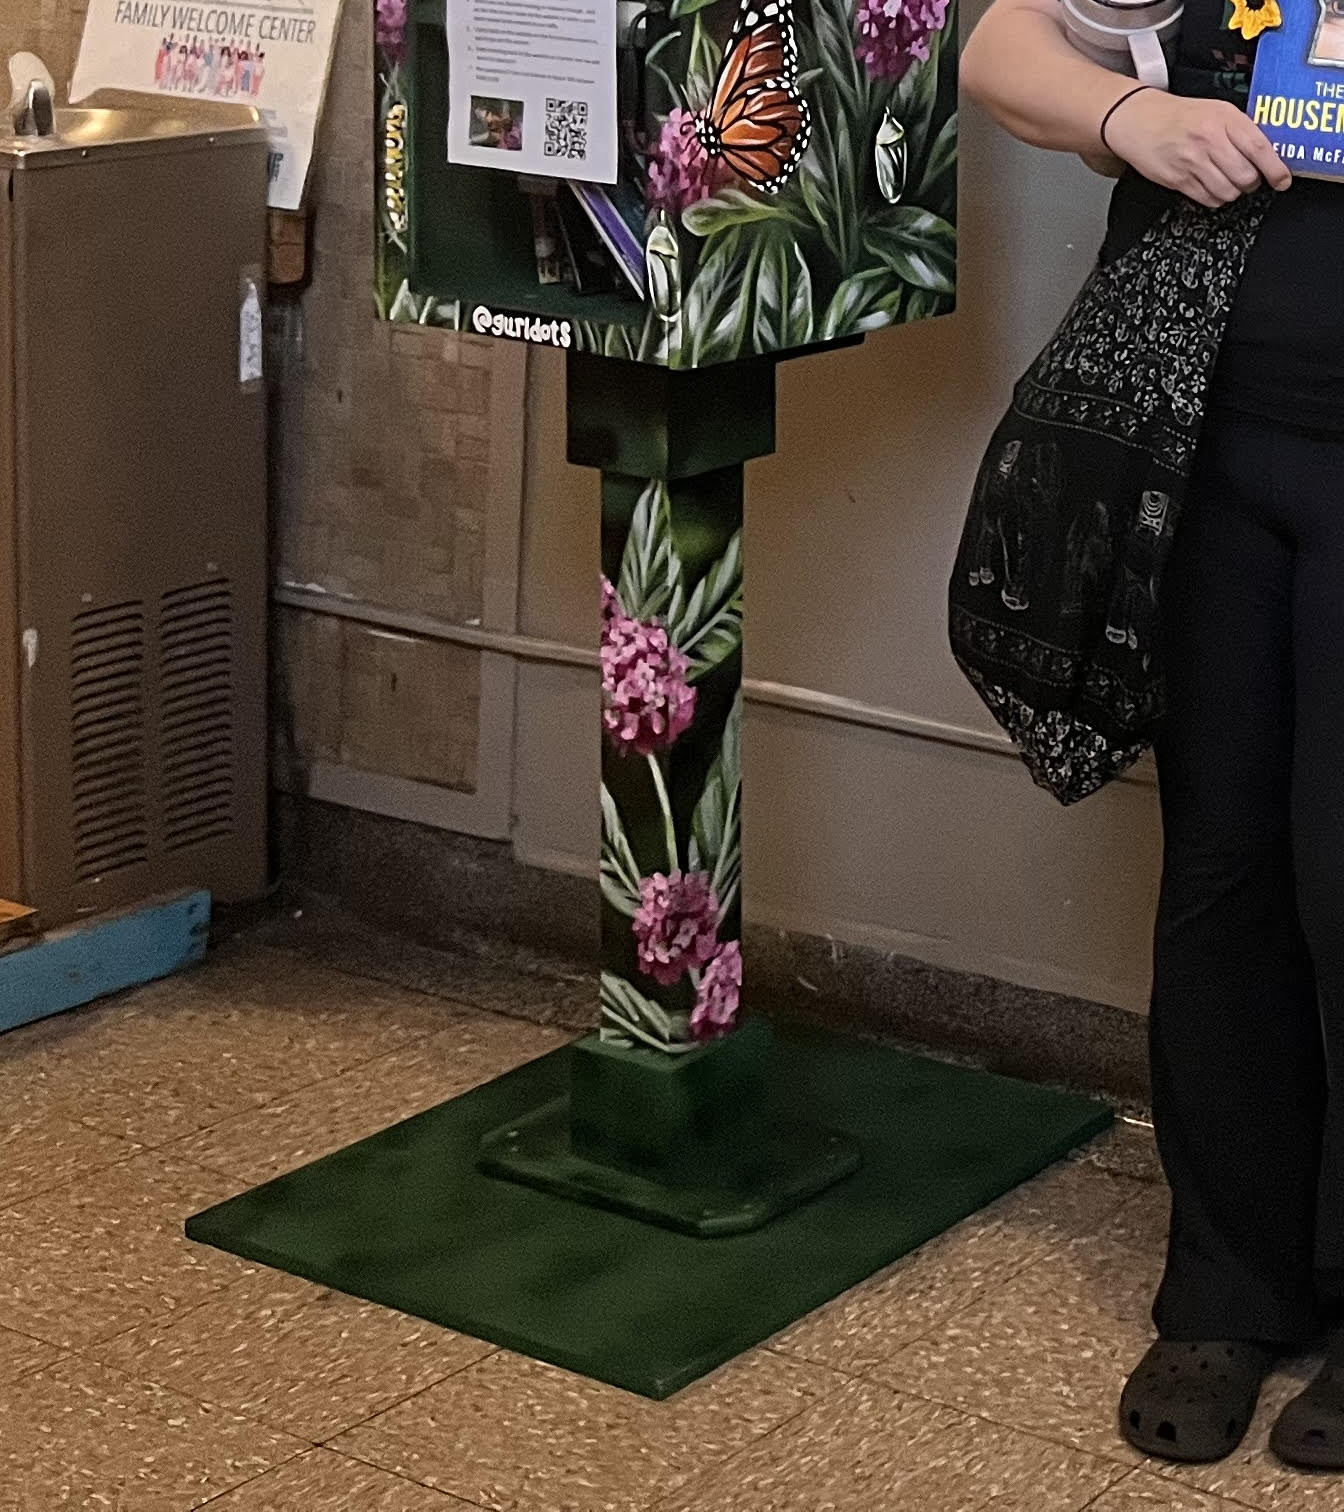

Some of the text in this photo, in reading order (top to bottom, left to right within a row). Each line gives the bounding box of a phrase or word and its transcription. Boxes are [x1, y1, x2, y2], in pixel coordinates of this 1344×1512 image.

[115, 0, 317, 44] FAMILY WELCOME CENTER
[1273, 142, 1305, 160] EIDA
[471, 305, 573, 349] @gurldots
